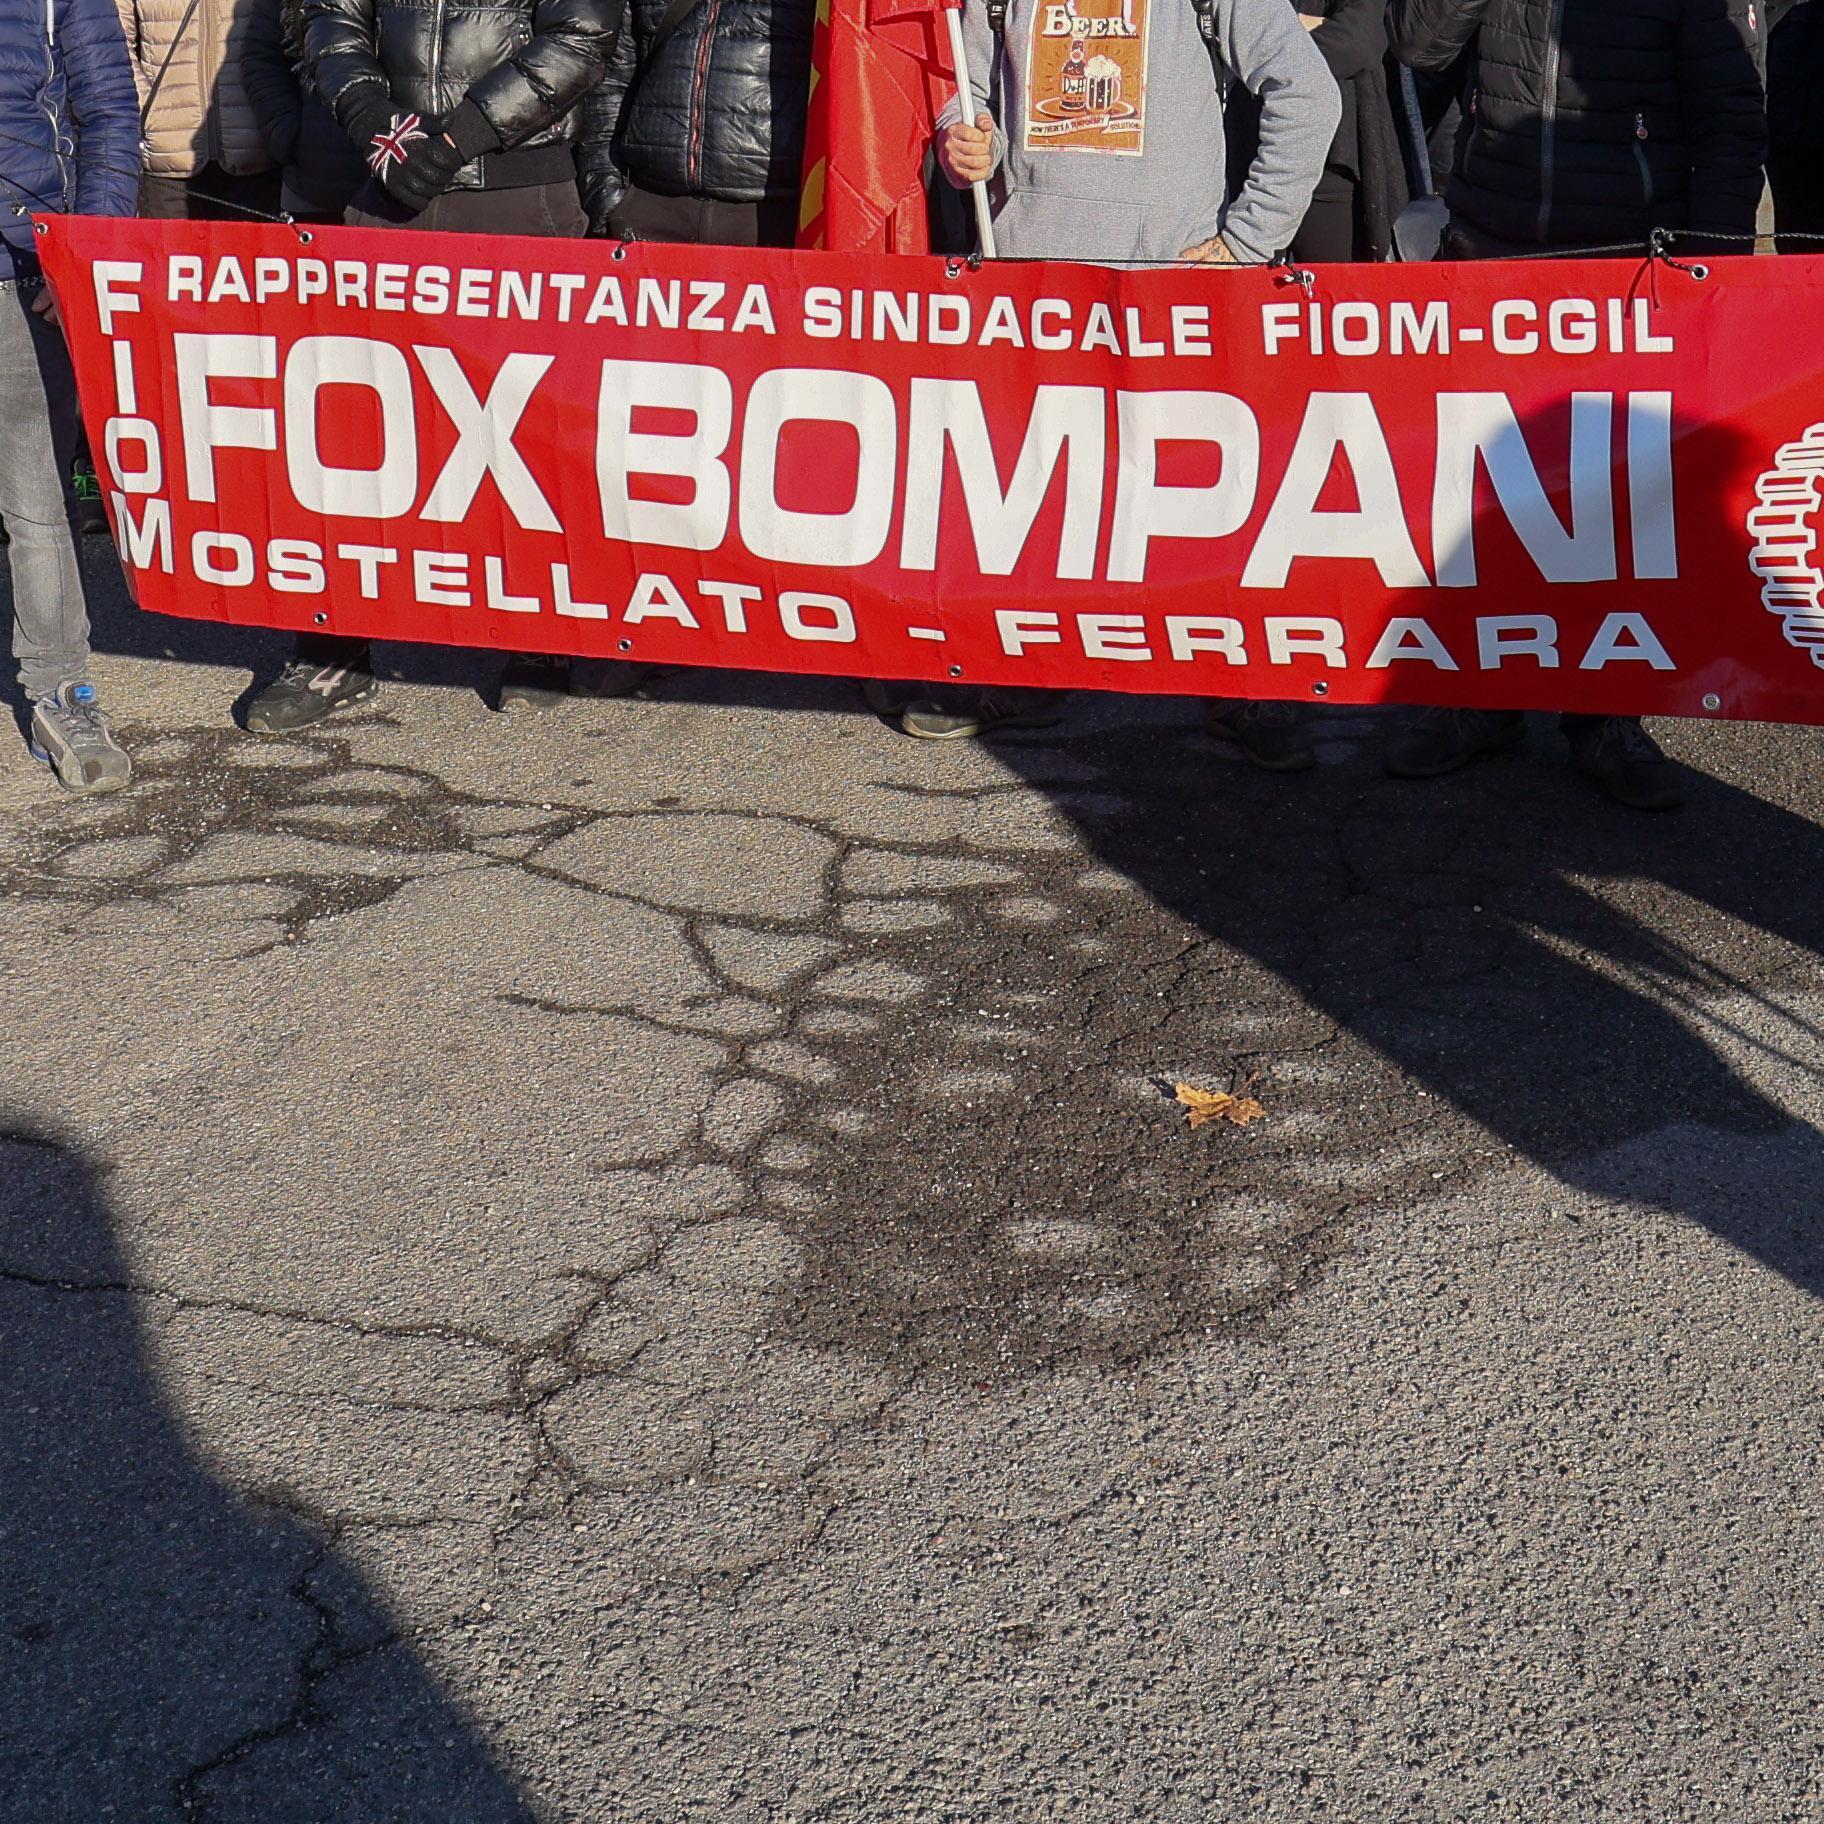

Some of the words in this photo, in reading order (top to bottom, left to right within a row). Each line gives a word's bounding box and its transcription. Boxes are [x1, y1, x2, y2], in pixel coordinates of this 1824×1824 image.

[167, 255, 777, 335] RAPPRESENTANZA
[803, 286, 1212, 358] SINDACALE
[1261, 298, 1675, 356] FIOM-CGIL
[174, 332, 564, 534] FOX
[595, 358, 1678, 589] BOMPANI
[994, 609, 1677, 671] FERRARA
